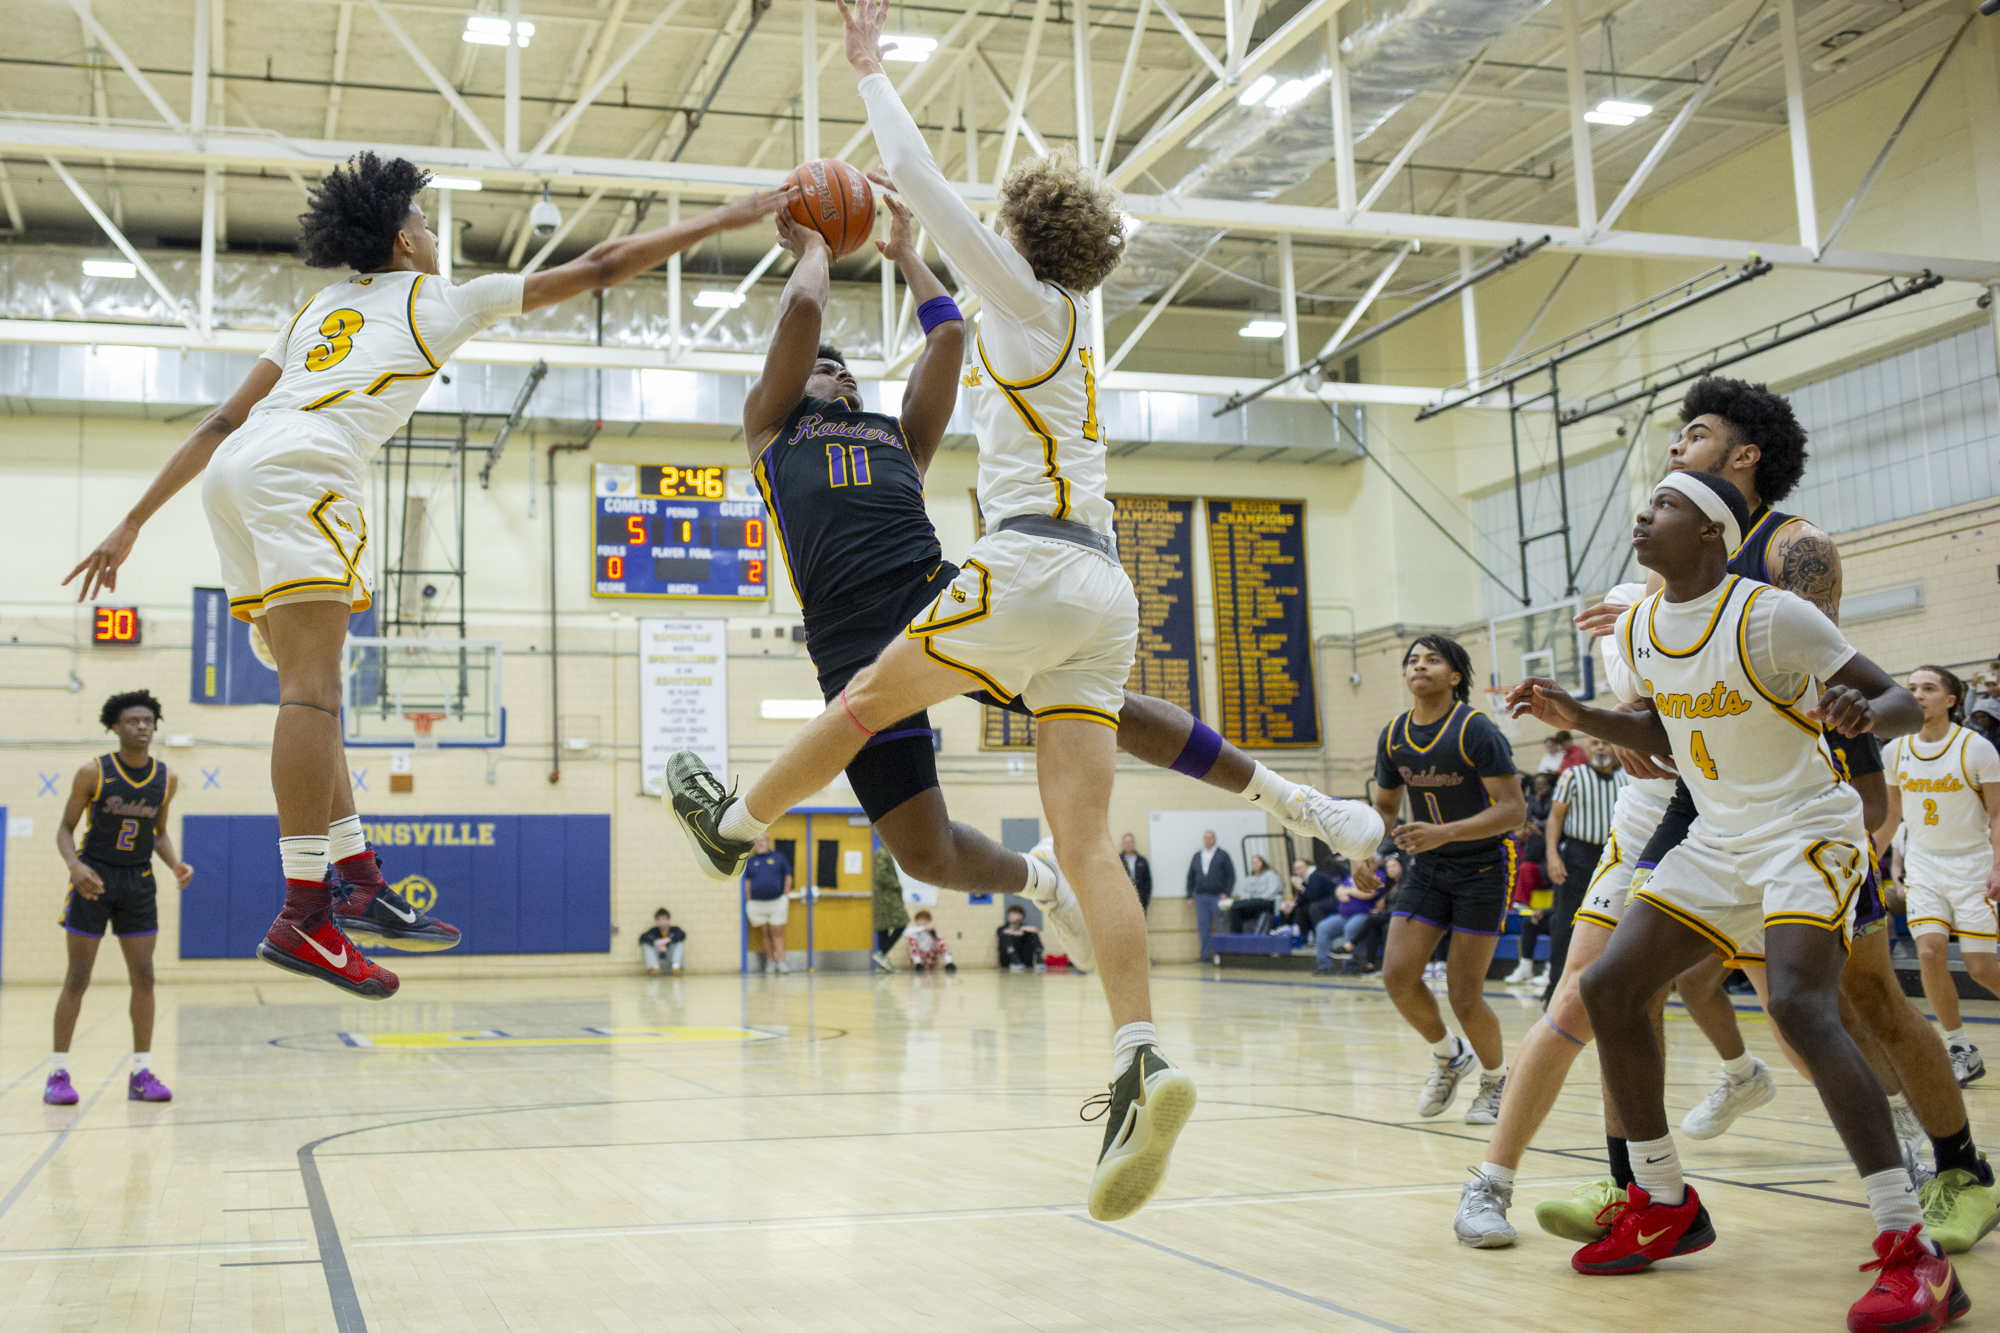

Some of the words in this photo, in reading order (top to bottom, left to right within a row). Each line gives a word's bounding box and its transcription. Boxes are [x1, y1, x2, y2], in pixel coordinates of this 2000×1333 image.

[305, 308, 364, 372] 3
[788, 412, 903, 449] Raiders
[826, 443, 872, 488] 11
[660, 466, 723, 498] 2:46
[604, 499, 657, 514] COMETS
[719, 502, 762, 517] GUEST
[1112, 510, 1183, 524] HAMPIONS
[1217, 512, 1294, 526] CHAMPIONS
[627, 515, 647, 545] 5
[682, 520, 691, 543] 1
[745, 519, 764, 548] 0
[607, 555, 623, 580] 0
[748, 559, 764, 583] 2
[95, 608, 136, 641] 30
[1690, 730, 1718, 780] 4
[1399, 765, 1464, 787] Raiders
[1899, 771, 1964, 792] Comets
[1424, 791, 1445, 825] 1
[1923, 798, 1938, 826] 2
[116, 818, 139, 851] 2
[361, 823, 495, 846] ONSVILLE
